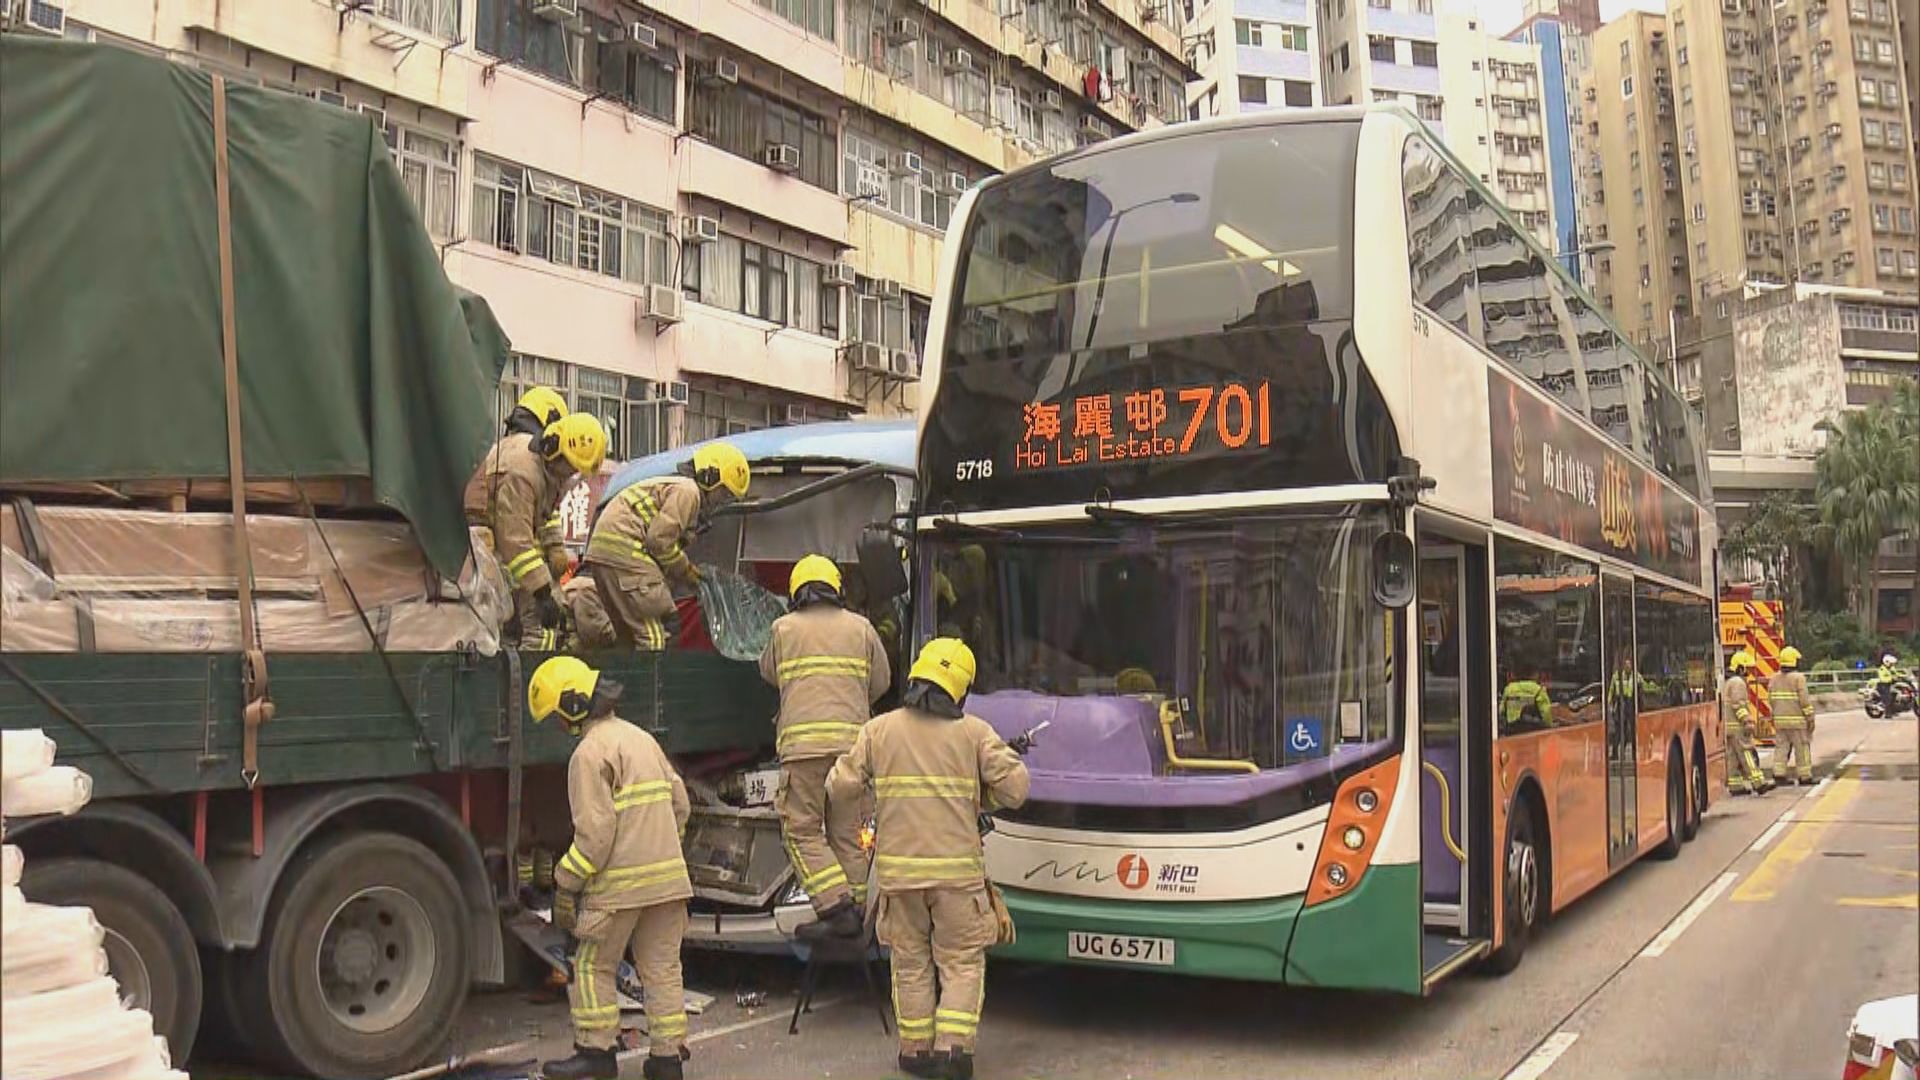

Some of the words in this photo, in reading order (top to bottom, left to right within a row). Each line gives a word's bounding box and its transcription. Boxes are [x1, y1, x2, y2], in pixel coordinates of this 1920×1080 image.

[1413, 311, 1429, 338] 5718
[1023, 388, 1167, 442] 海麗邨
[1178, 380, 1270, 453] 701
[1016, 443, 1046, 469] Hoi
[1057, 439, 1088, 465] Lai
[1099, 431, 1175, 461] Estate
[956, 460, 993, 481] 5718
[1158, 863, 1199, 883] 新巴
[1156, 884, 1178, 892] FIRST
[1179, 885, 1196, 893] BUS
[1076, 933, 1103, 955] UG
[1110, 938, 1164, 960] 6571
